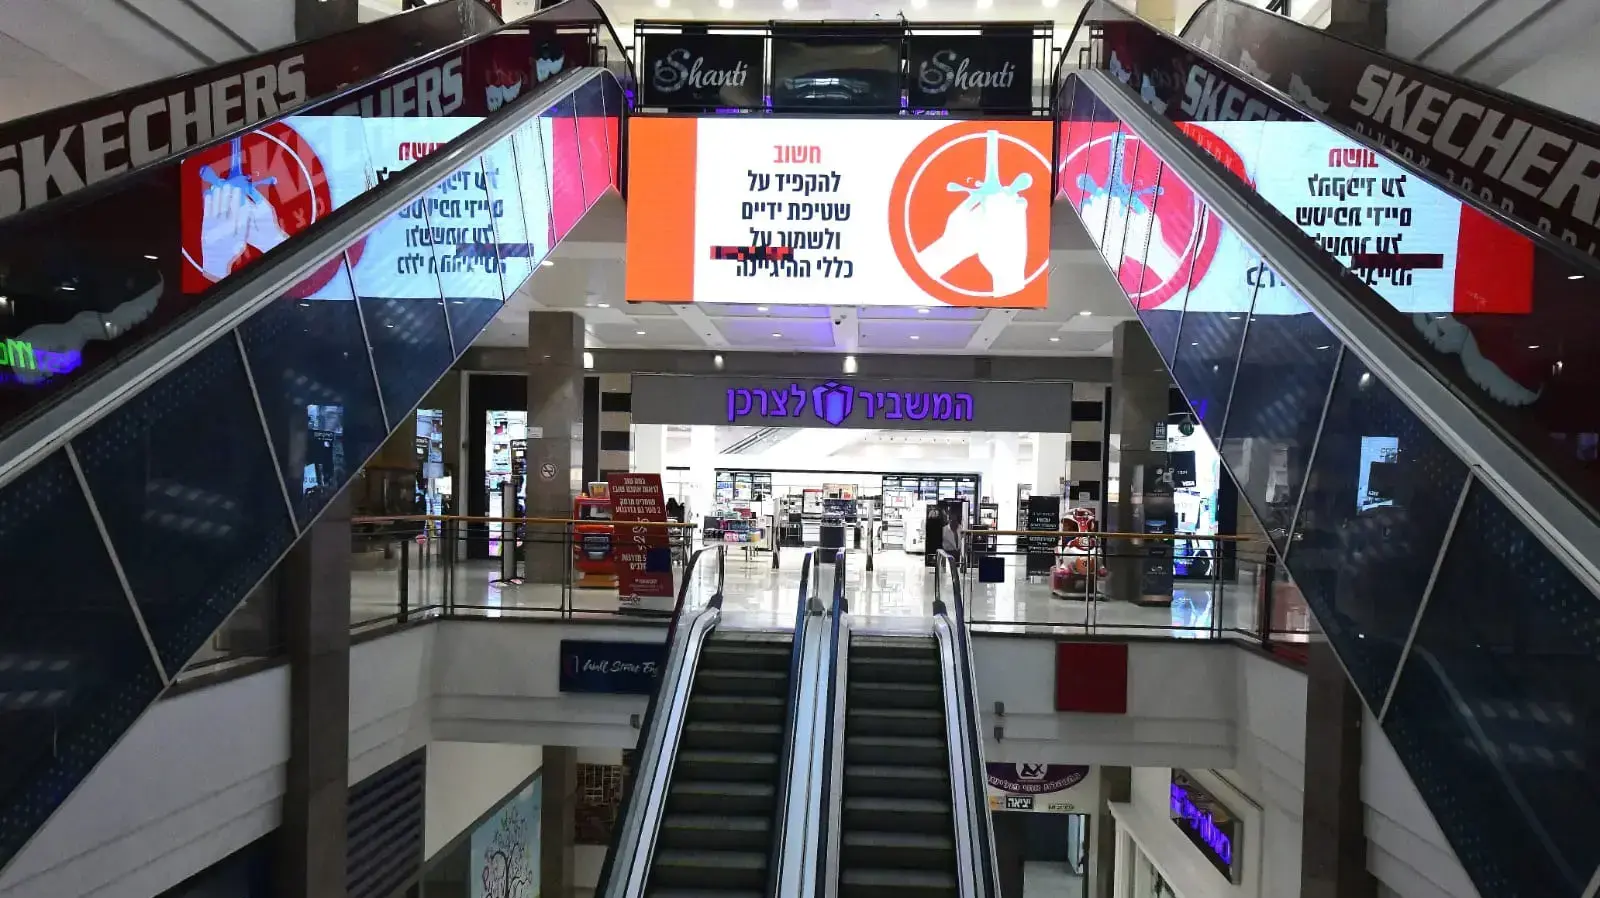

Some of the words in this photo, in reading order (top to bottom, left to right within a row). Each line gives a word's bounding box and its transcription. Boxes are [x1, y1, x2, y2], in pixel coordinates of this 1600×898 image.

[653, 47, 748, 92] Shanti
[918, 49, 1016, 94] Shanti
[773, 145, 822, 164] חשוב
[1350, 65, 1600, 232] SKECHER
[747, 171, 771, 192] על
[775, 171, 841, 196] להקפיד
[741, 202, 784, 221] ידיים
[787, 202, 850, 221] שטיפת
[749, 228, 772, 249] על
[775, 229, 841, 249] ולשמור
[736, 258, 812, 278] ההיגיינה
[818, 257, 854, 279] כללי
[727, 383, 805, 422] לצרכן
[858, 391, 974, 421] המשביר
[582, 659, 608, 674] Wall
[609, 661, 640, 673] Street
[1008, 797, 1032, 809] יציאה
